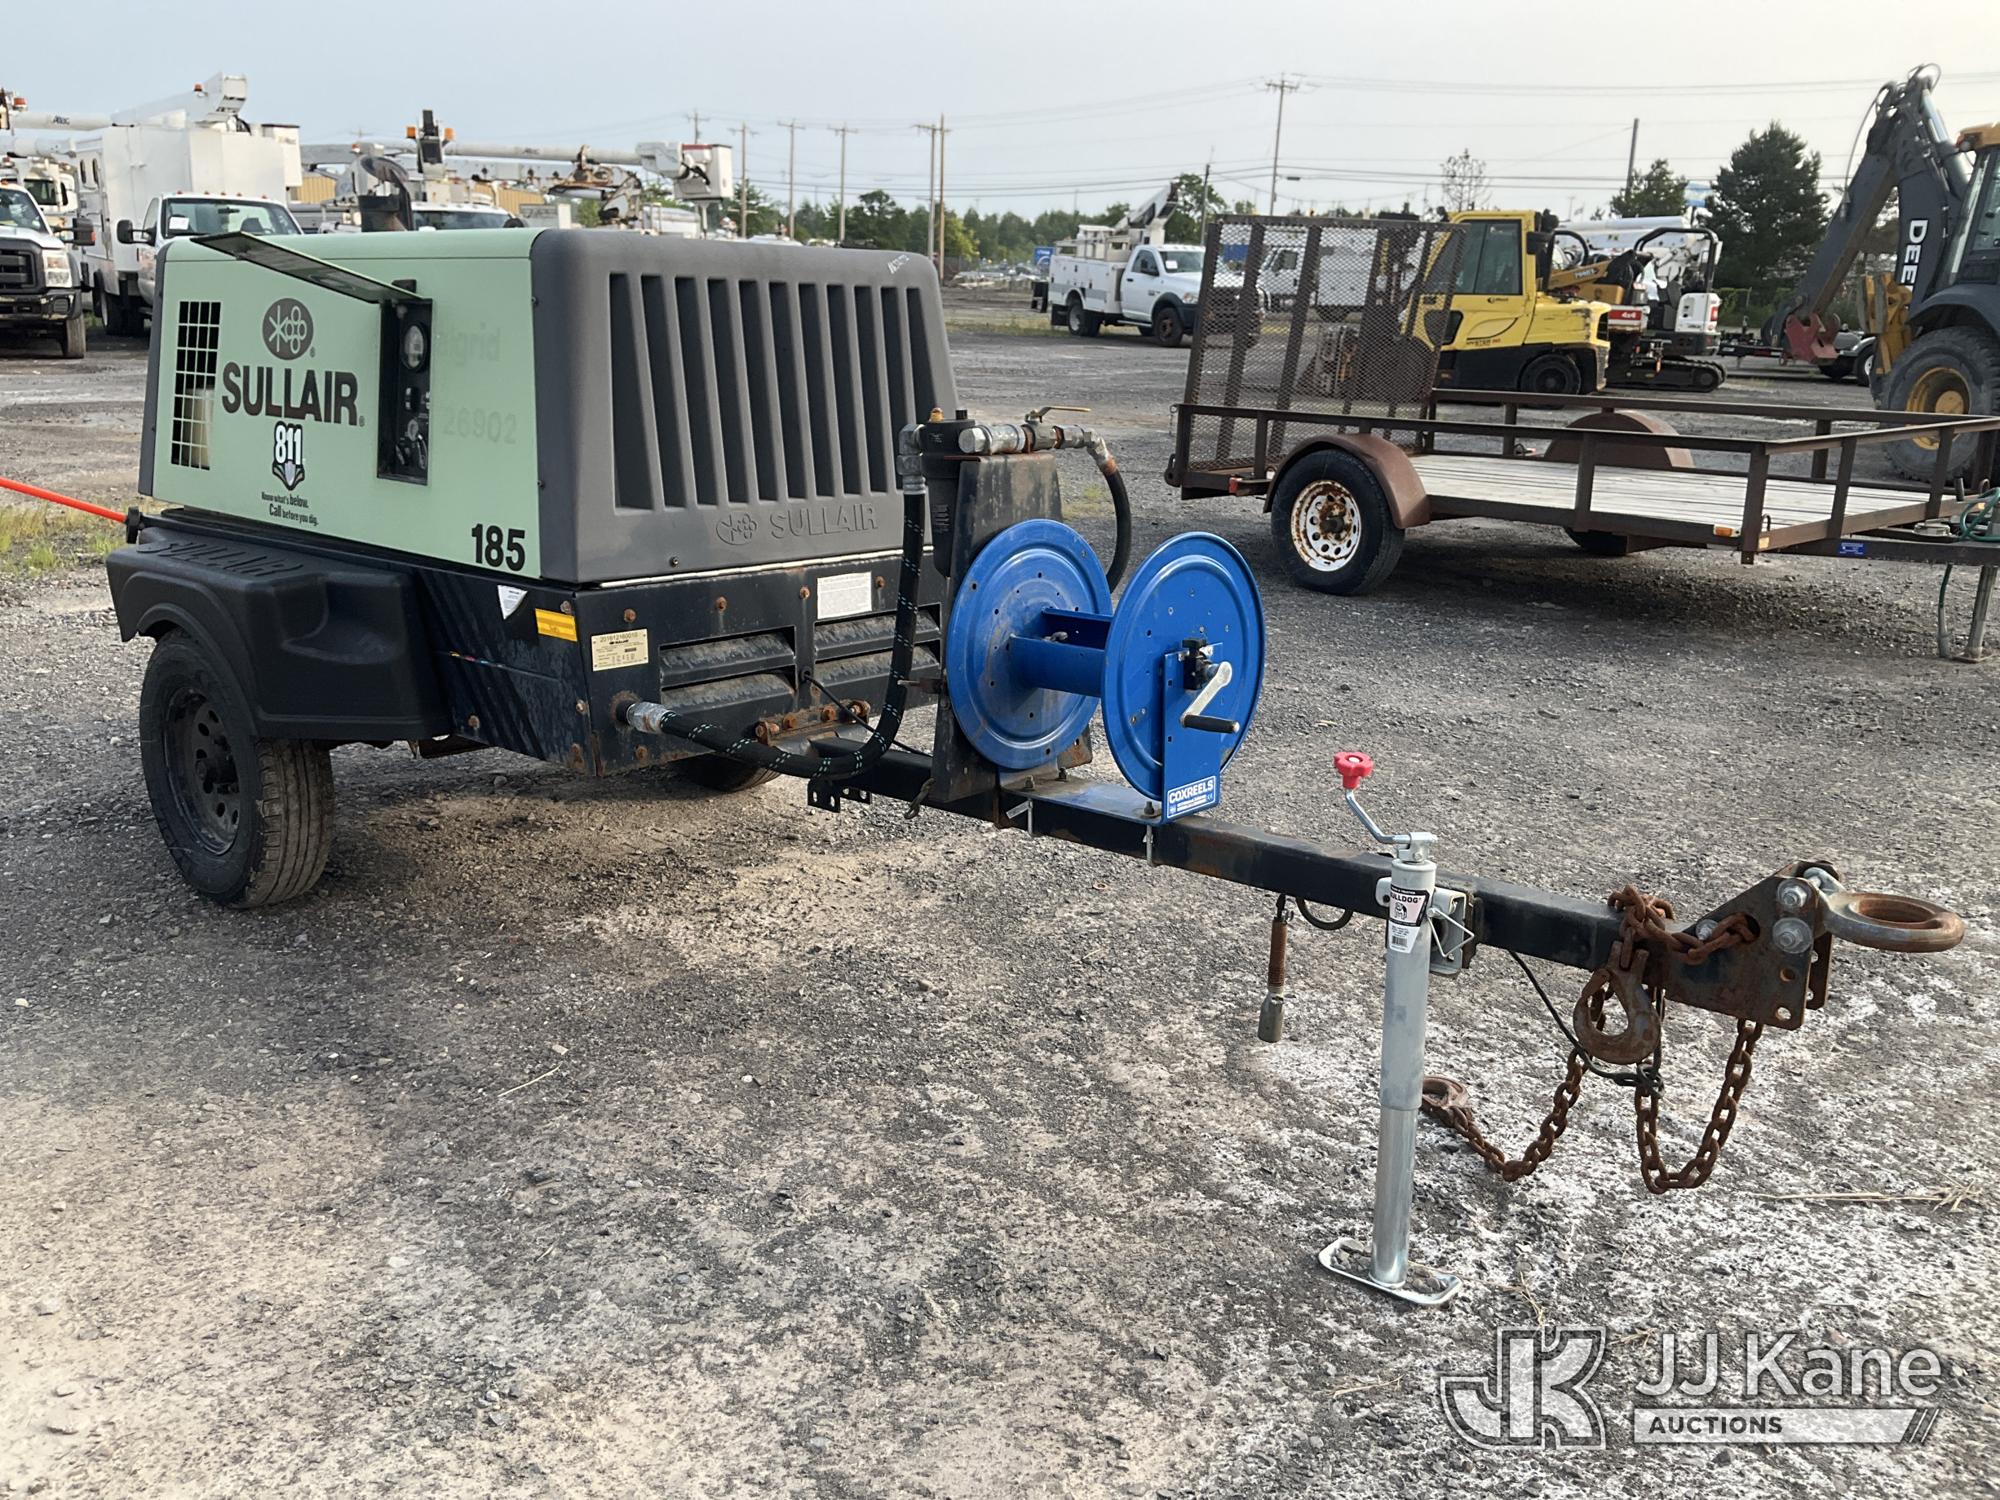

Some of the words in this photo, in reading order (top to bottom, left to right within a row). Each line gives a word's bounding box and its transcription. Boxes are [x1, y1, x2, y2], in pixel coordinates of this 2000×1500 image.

[1901, 219, 1928, 293] DEE
[222, 361, 358, 426] SULLAIR
[274, 423, 303, 466] 811
[269, 503, 281, 517] Call
[282, 509, 299, 521] before
[299, 513, 308, 524] you
[770, 503, 879, 539] SULLAIR
[471, 523, 526, 572] 185
[1169, 780, 1214, 804] COXREELS
